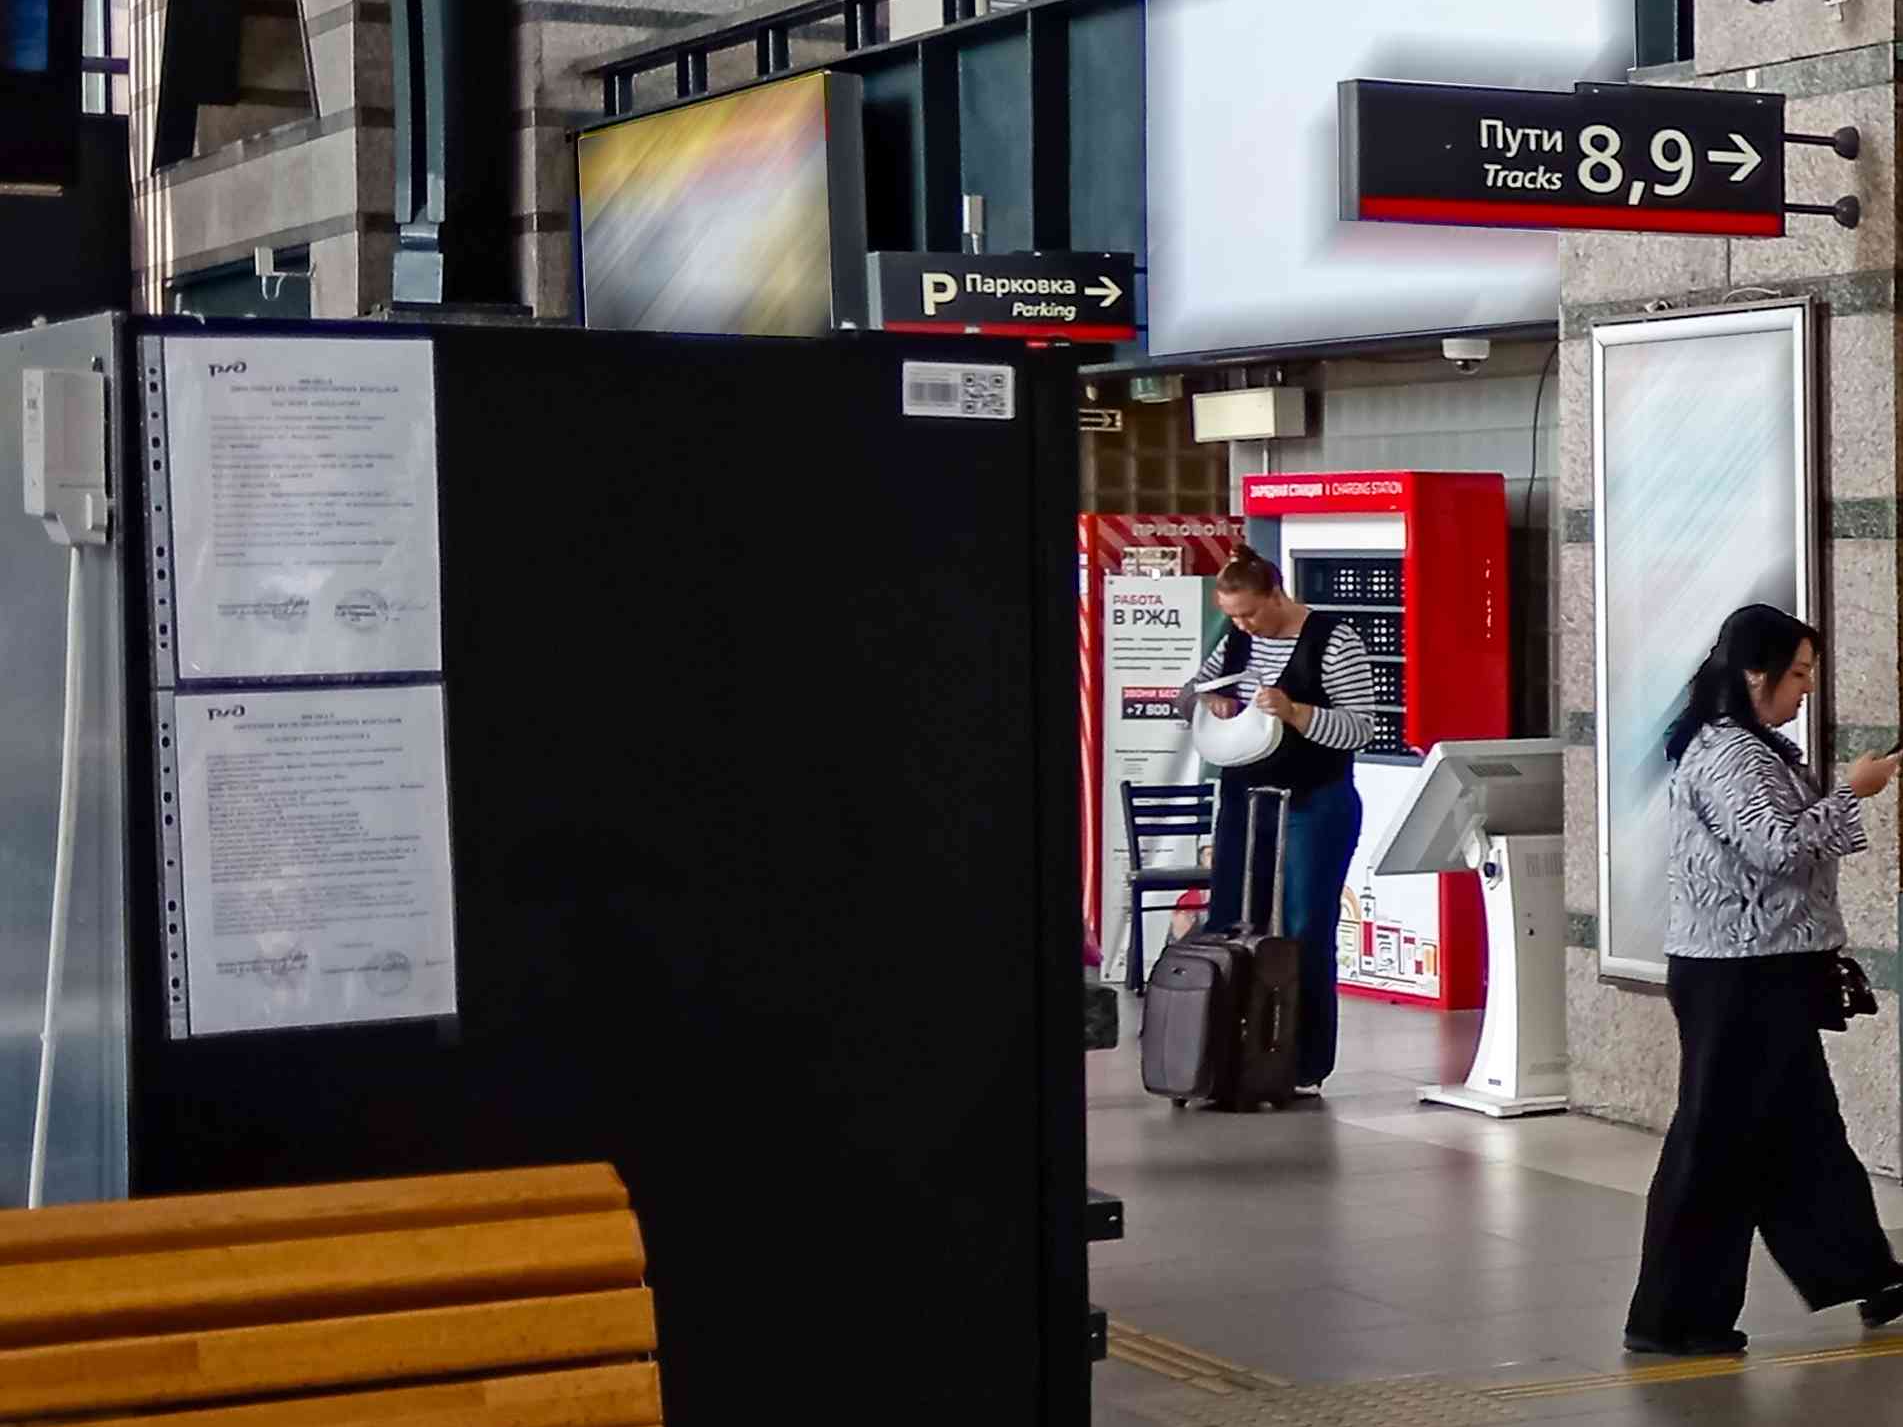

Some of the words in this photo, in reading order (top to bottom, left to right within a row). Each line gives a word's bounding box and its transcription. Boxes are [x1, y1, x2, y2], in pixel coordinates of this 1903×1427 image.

[1480, 118, 1563, 157] Пути
[1483, 163, 1562, 189] Tracks
[1577, 124, 1694, 205] 8,9
[965, 273, 1077, 297] Парковка
[1012, 301, 1077, 321] Parking
[1113, 595, 1163, 605] РАБОТА
[1113, 609, 1125, 625] В
[1132, 609, 1181, 628] РЖД
